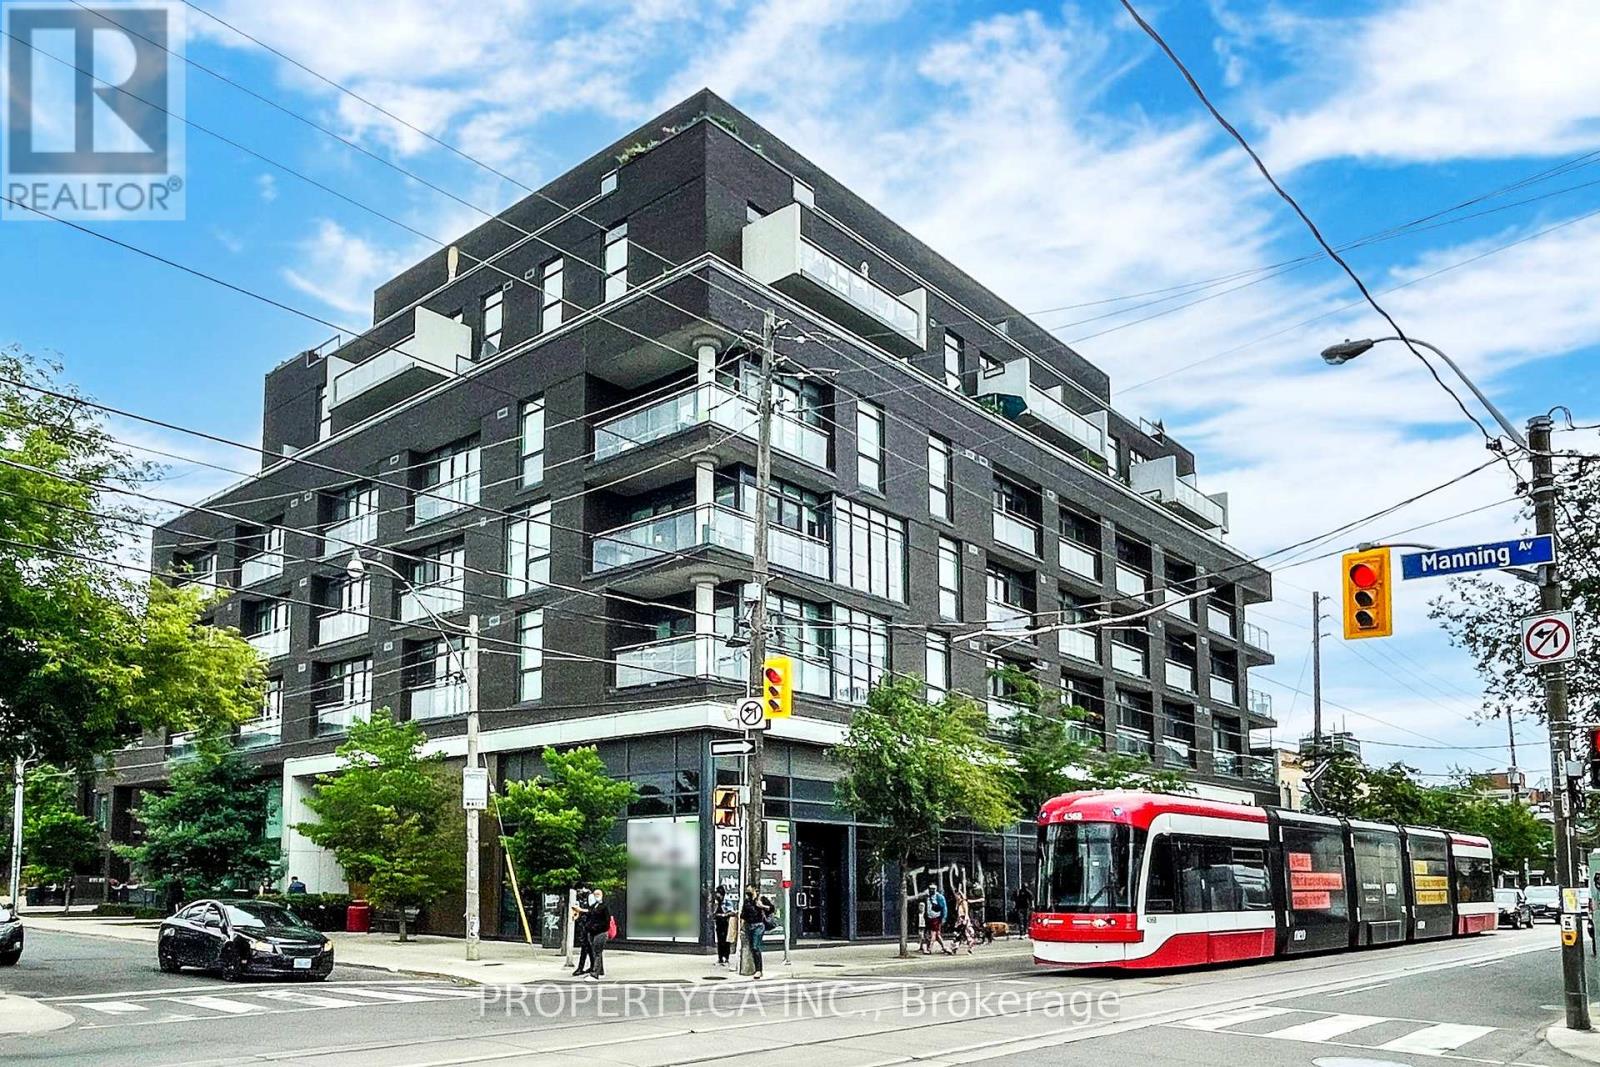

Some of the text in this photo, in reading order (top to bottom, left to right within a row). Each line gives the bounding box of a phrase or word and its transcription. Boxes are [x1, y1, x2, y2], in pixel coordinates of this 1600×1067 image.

[1421, 540, 1533, 572] Manning Av
[721, 834, 741, 847] RET
[721, 851, 740, 864] FO
